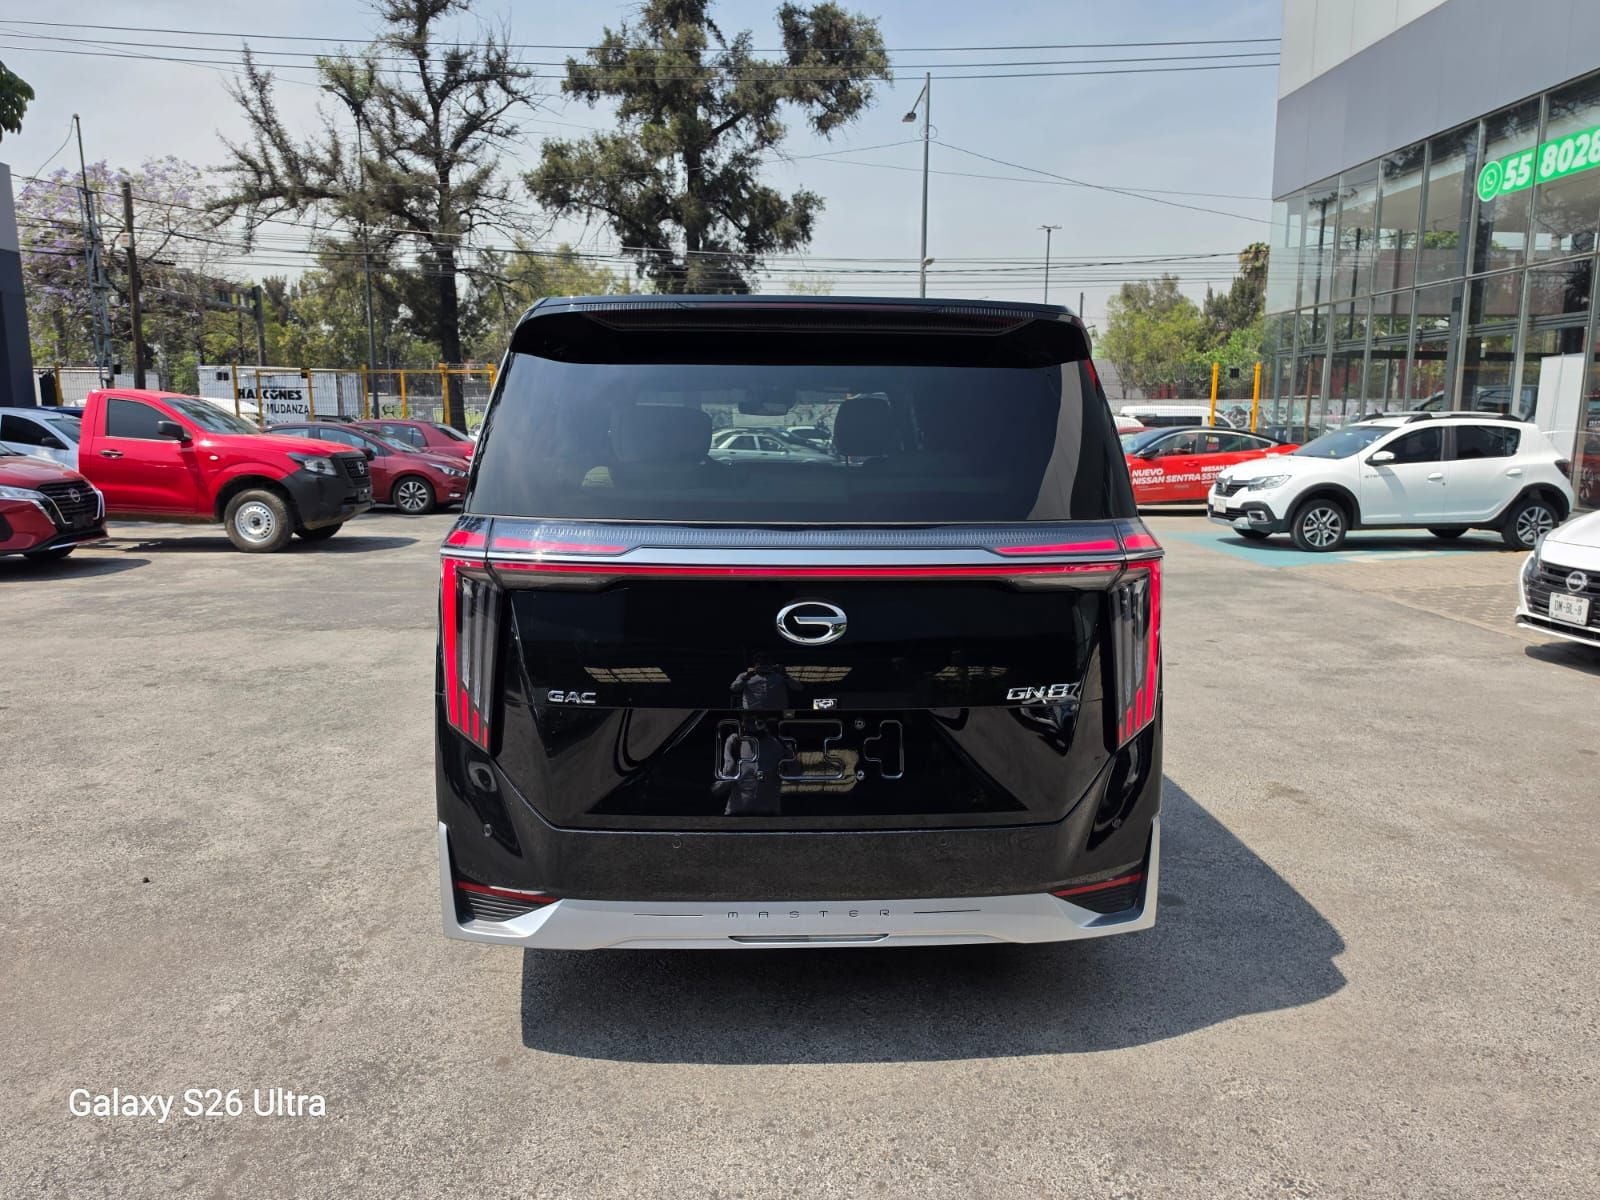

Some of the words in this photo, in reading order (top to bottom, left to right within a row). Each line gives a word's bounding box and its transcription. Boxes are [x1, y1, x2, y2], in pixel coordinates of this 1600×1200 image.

[1502, 152, 1533, 190] 55
[1540, 129, 1600, 178] 8028
[1131, 468, 1164, 477] NUEVO
[1131, 475, 1165, 485] NISSAN
[1165, 473, 1201, 483] SENTRA
[547, 690, 597, 704] GAC
[727, 909, 890, 919] MASTER
